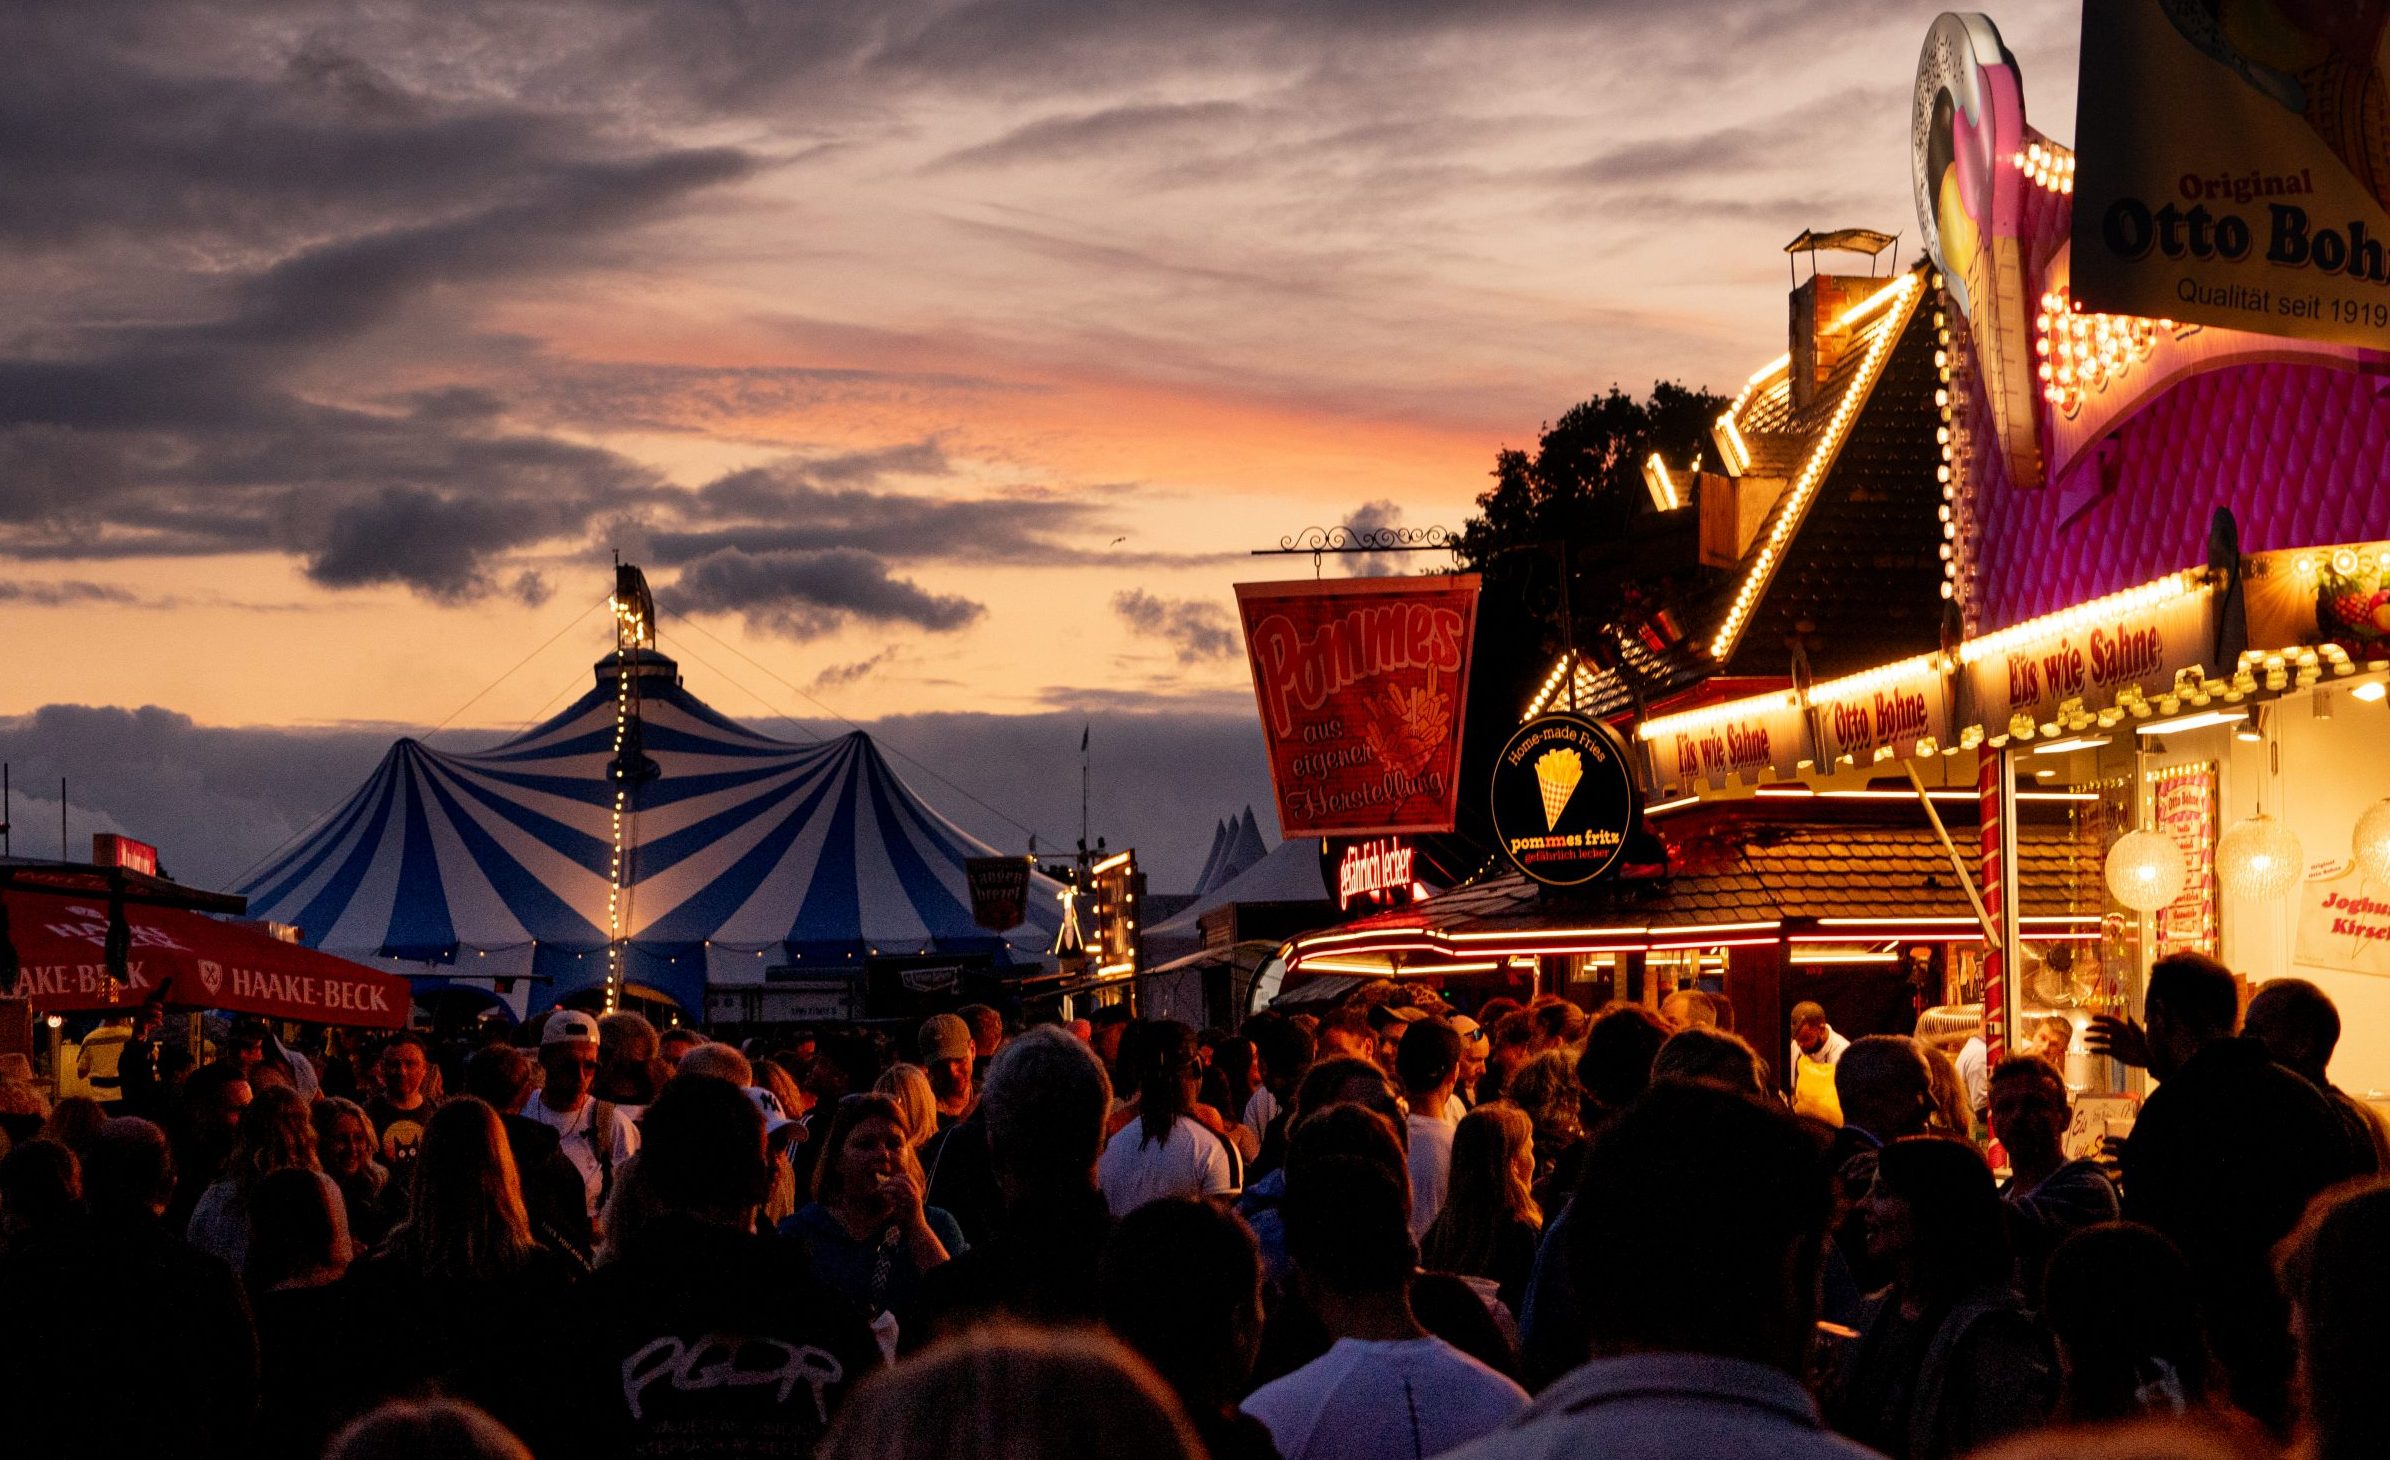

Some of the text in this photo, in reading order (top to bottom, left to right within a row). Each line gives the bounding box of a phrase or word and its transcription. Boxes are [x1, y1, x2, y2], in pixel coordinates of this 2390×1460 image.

[2179, 169, 2314, 203] Original
[2103, 198, 2390, 285] Otto Boh
[2177, 277, 2388, 328] Qualität seit 1919
[1252, 602, 1465, 740] Pommes
[2008, 622, 2163, 709] Eis wie Sahne
[1303, 719, 1344, 745] aus
[1834, 702, 1872, 751] Otto
[1874, 688, 1929, 745] Bohne
[1292, 742, 1374, 782] eigener
[1508, 726, 1606, 767] Home-made Fries
[1700, 727, 1727, 775] wie
[1727, 721, 1771, 769] Sahne
[1286, 770, 1446, 821] Herstellung
[1381, 835, 1412, 889] lecker
[1510, 828, 1620, 853] pommes fritz
[1524, 848, 1610, 865] gefährlich lecker
[232, 967, 391, 1012] HAAKE-BECK
